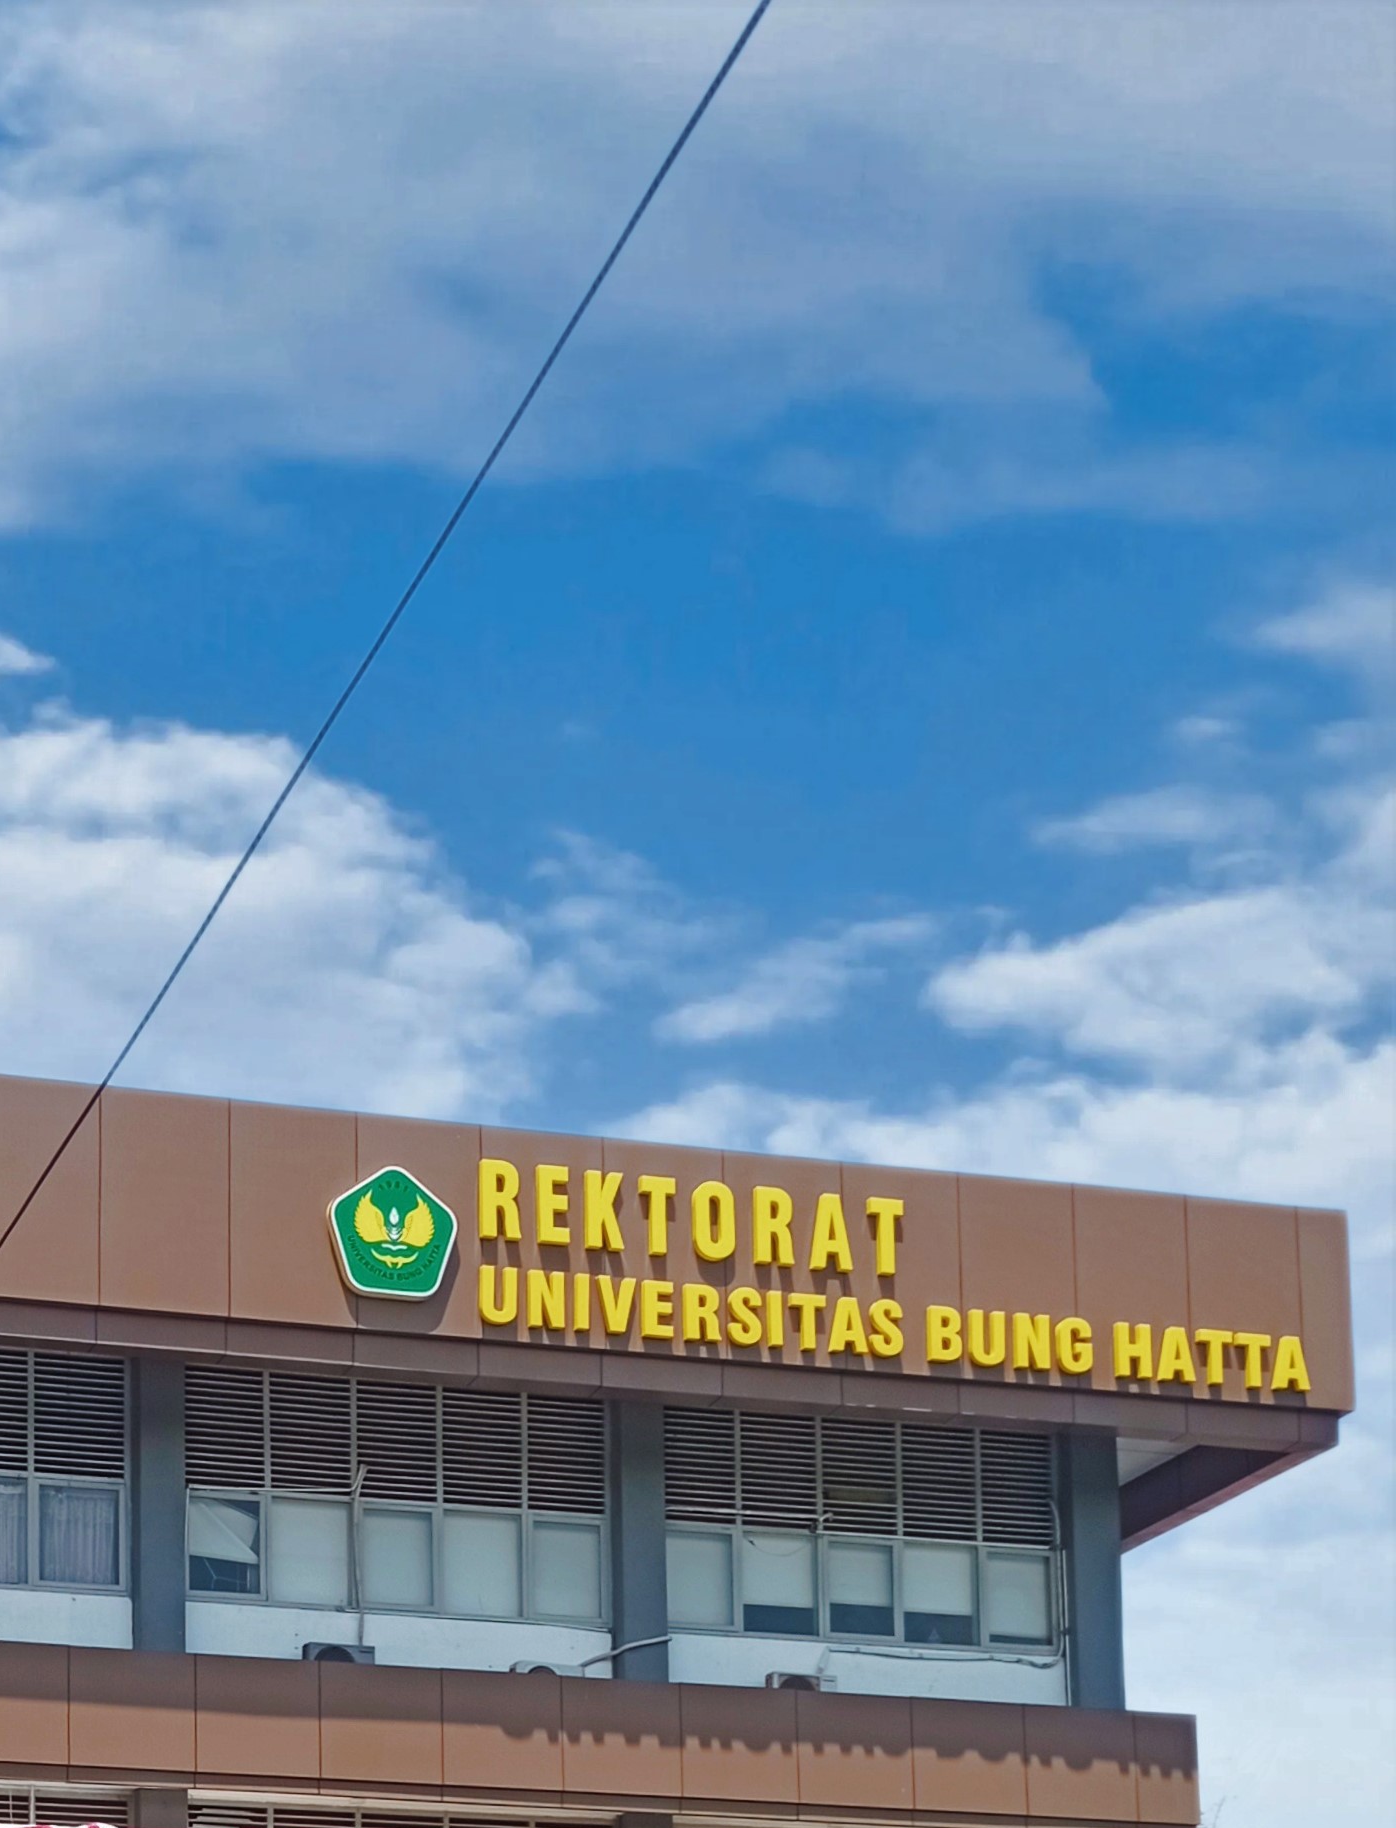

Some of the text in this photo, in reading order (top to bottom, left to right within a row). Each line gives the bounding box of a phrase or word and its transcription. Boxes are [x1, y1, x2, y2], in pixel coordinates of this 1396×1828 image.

[479, 1158, 904, 1277] REKTORAT
[478, 1264, 1311, 1392] UNIVERSITAS BUNG HATTA
